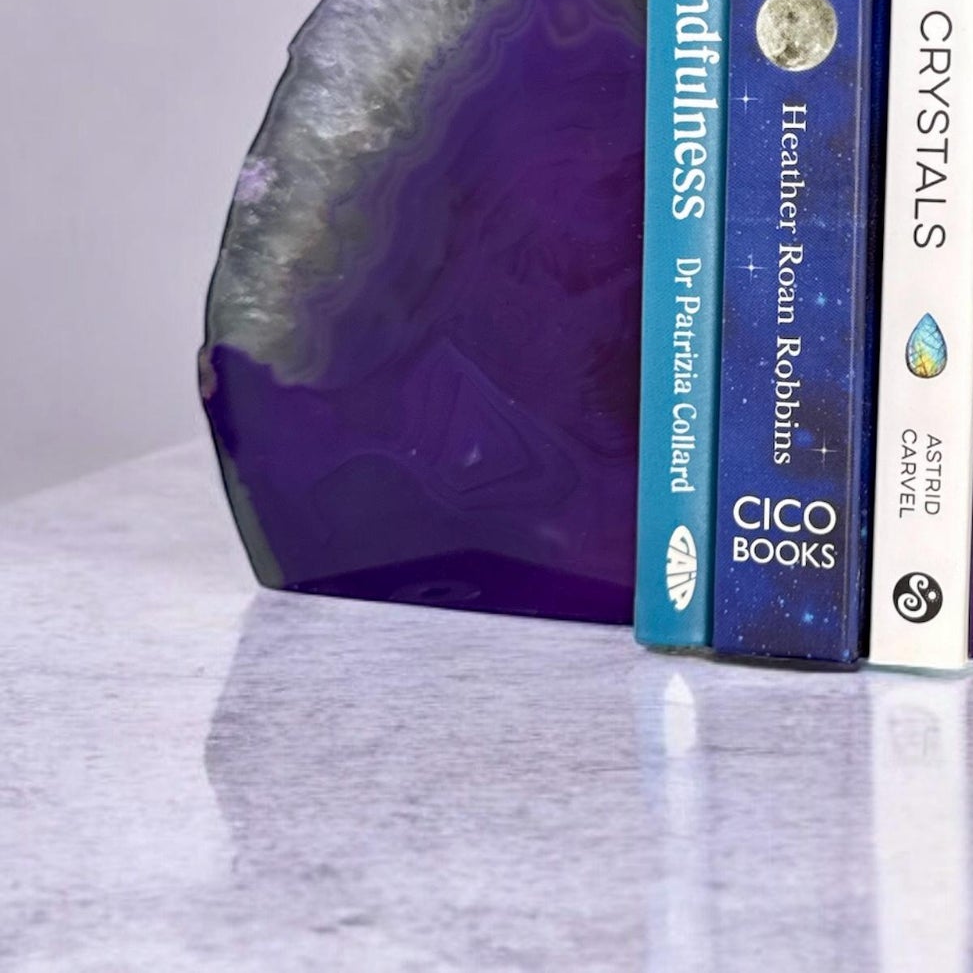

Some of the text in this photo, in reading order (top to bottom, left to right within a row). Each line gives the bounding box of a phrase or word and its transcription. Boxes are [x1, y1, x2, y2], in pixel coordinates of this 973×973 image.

[913, 10, 952, 249] CRYSTALS
[773, 103, 807, 465] Heather Roan Robbins
[670, 257, 702, 494] Dr Patrizia Collard
[732, 495, 837, 535] CICO
[899, 428, 917, 519] CARVEL
[924, 433, 942, 516] ASTRID
[732, 537, 836, 569] BOOKS
